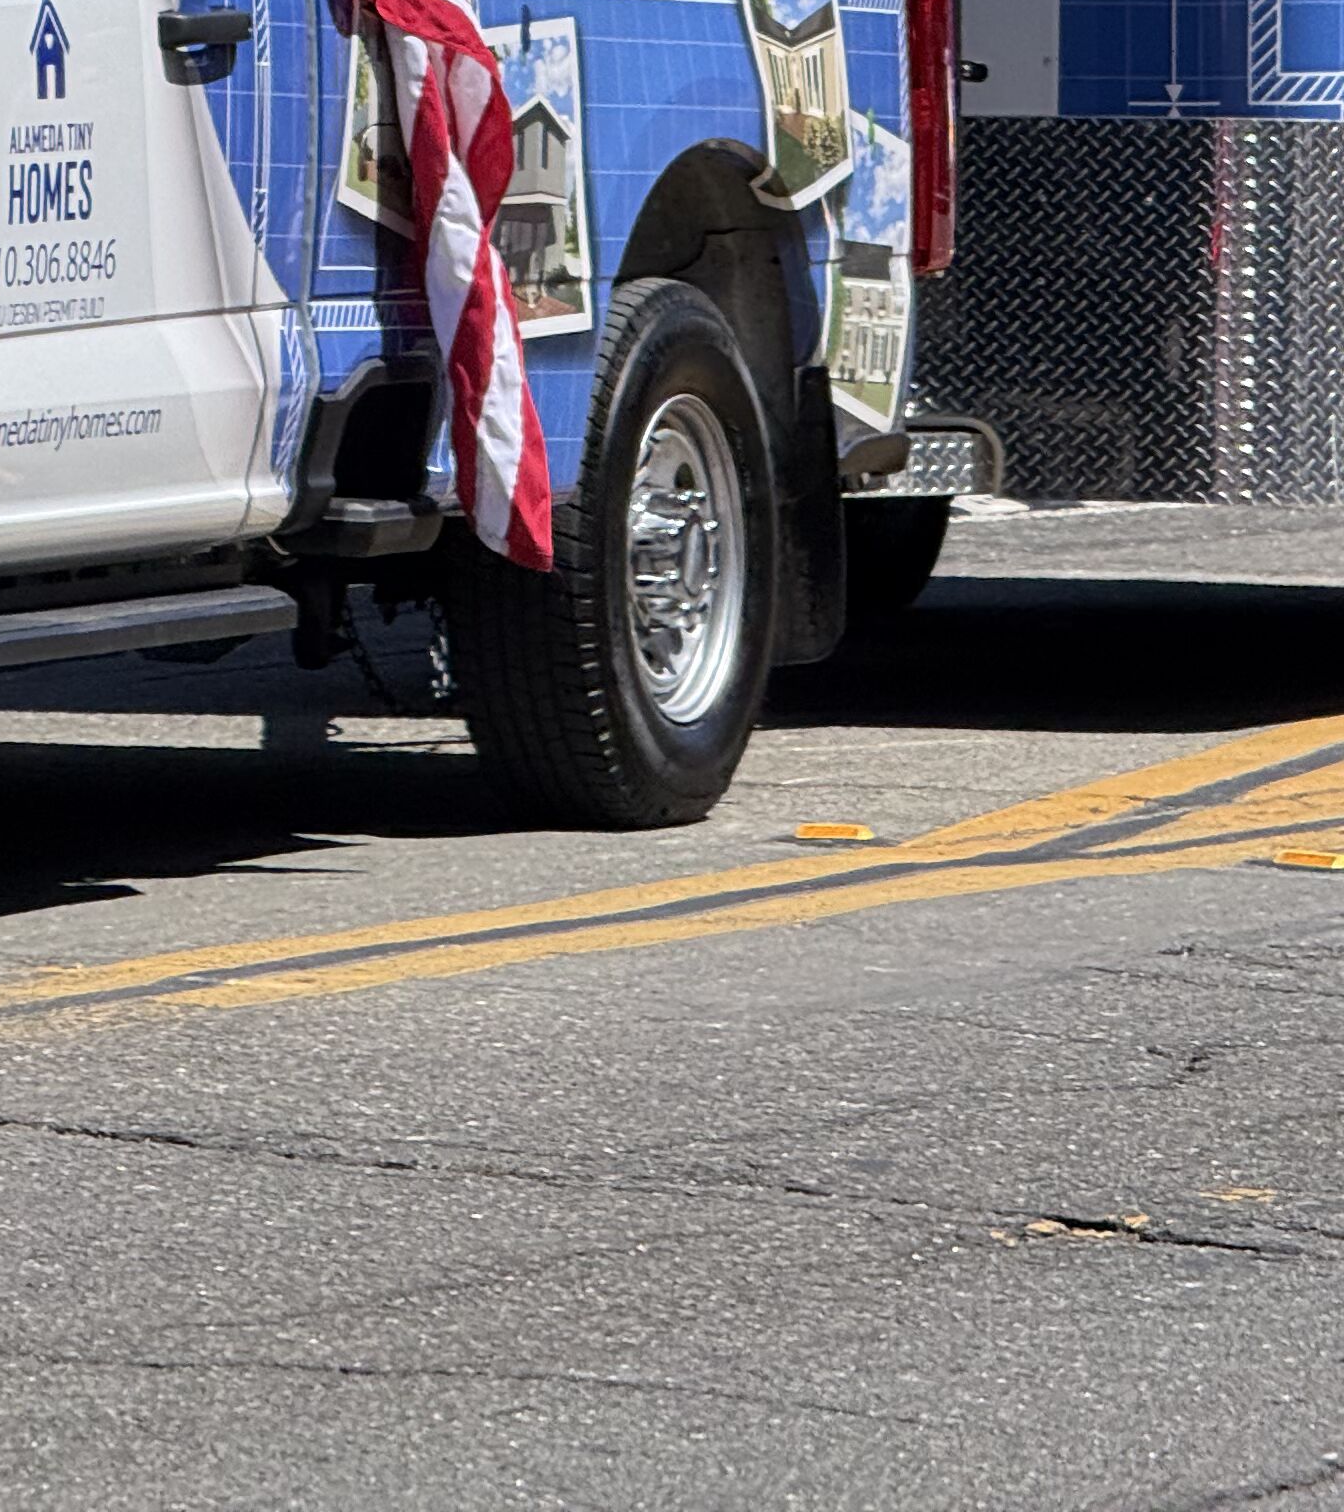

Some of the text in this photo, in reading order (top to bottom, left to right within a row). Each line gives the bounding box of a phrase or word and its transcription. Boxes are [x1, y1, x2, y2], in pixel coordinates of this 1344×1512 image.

[9, 121, 94, 154] ALAMEDA TINY
[8, 159, 93, 225] HOMES
